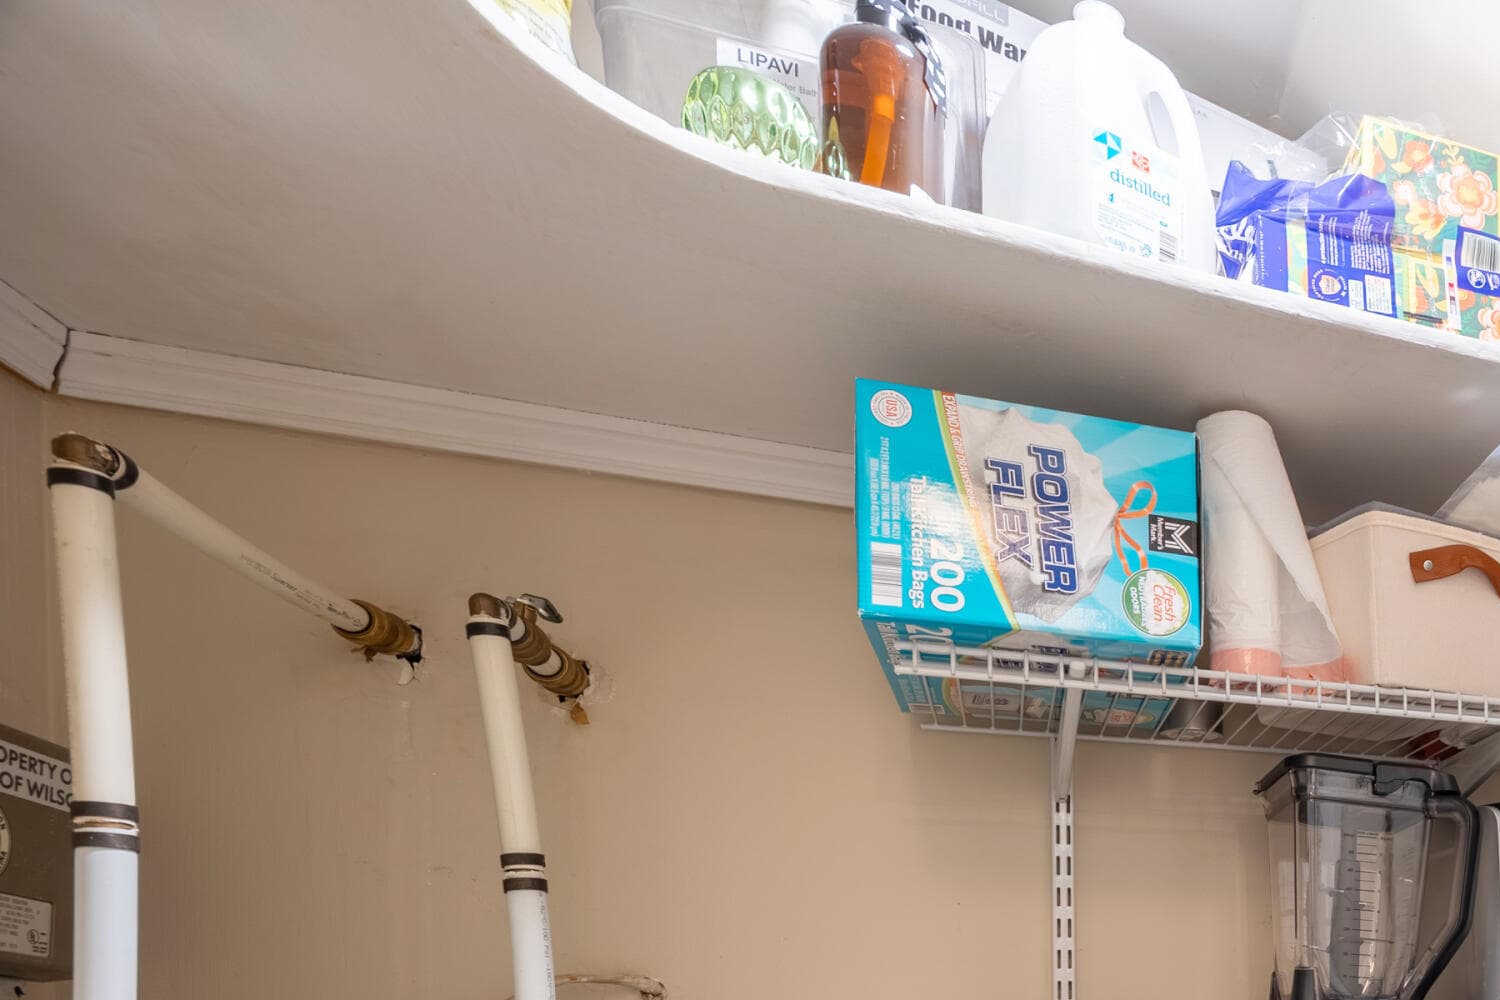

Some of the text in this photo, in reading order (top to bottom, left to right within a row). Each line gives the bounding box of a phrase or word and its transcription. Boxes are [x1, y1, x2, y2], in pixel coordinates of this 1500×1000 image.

[737, 47, 799, 78] LIPAVI
[1110, 169, 1171, 207] distilled
[885, 399, 898, 417] USA
[986, 457, 1035, 568] FLEX
[1030, 443, 1080, 594] POWER
[908, 569, 928, 609] Bags
[929, 538, 965, 612] 200
[1153, 584, 1166, 622] Clean
[1164, 585, 1177, 622] Fresh
